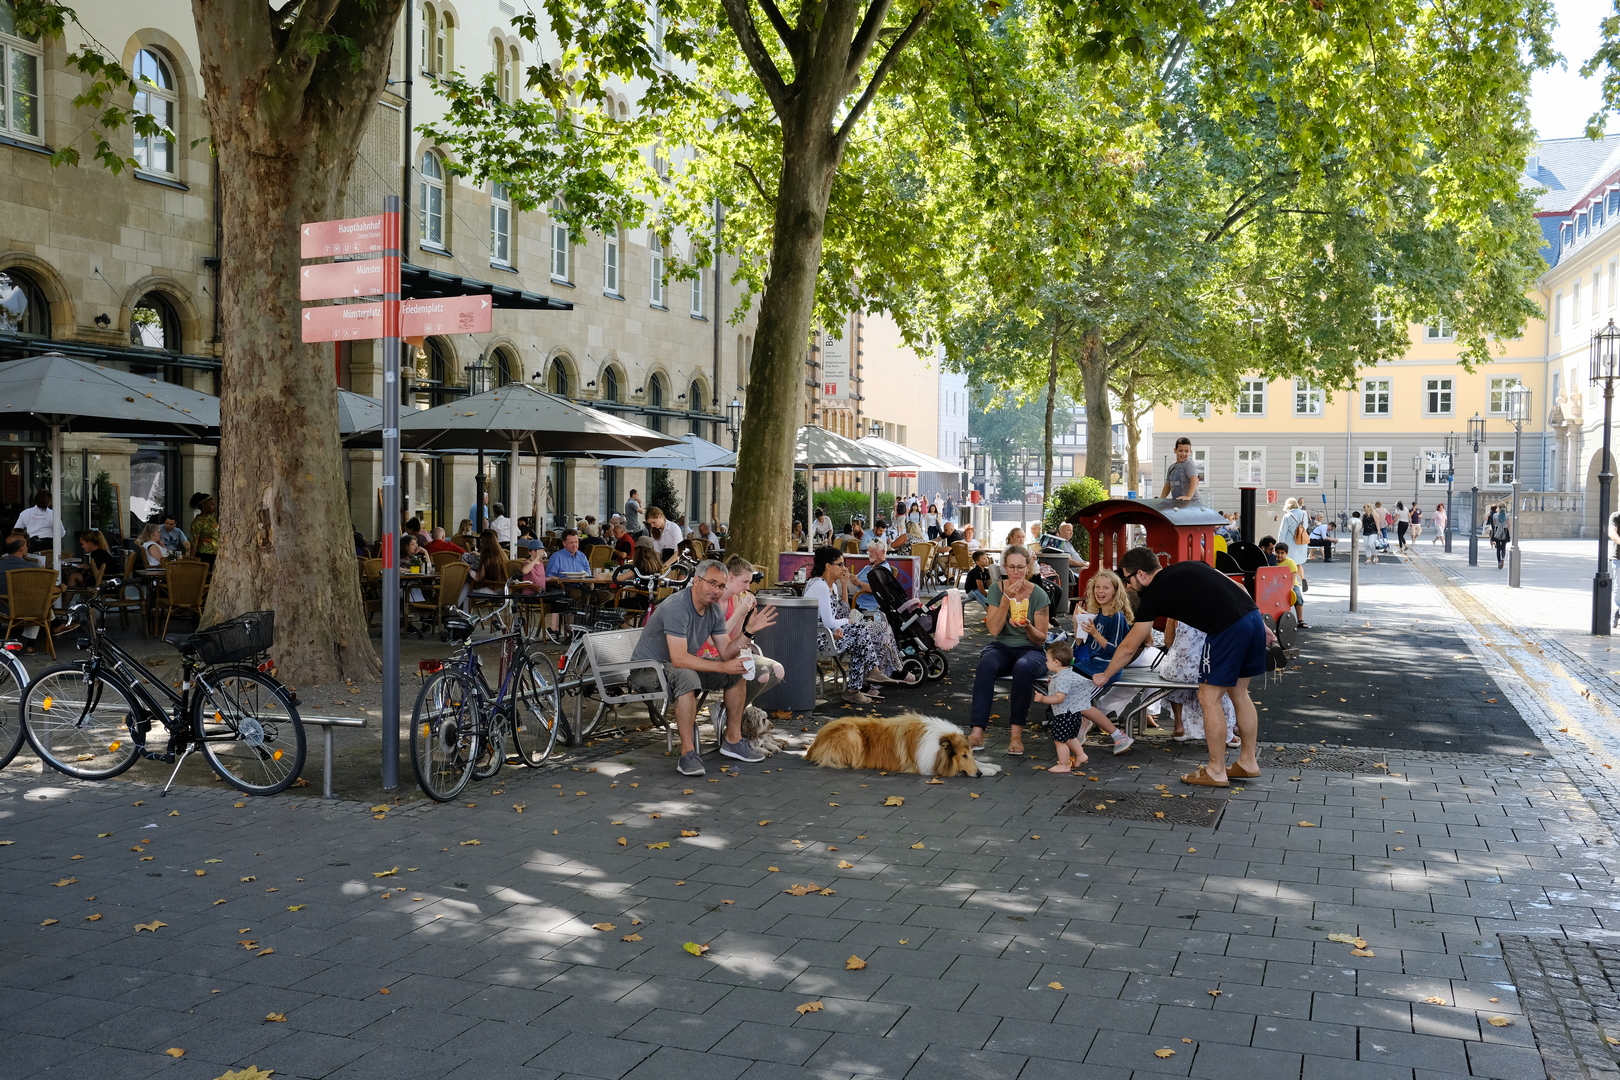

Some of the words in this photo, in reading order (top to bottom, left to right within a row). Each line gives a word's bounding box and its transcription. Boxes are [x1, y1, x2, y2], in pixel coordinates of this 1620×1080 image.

[338, 219, 381, 234] Hauptbahnhof
[356, 265, 381, 275] Münster
[342, 307, 381, 319] Münsterplatz
[402, 302, 444, 315] Friedensplatz
